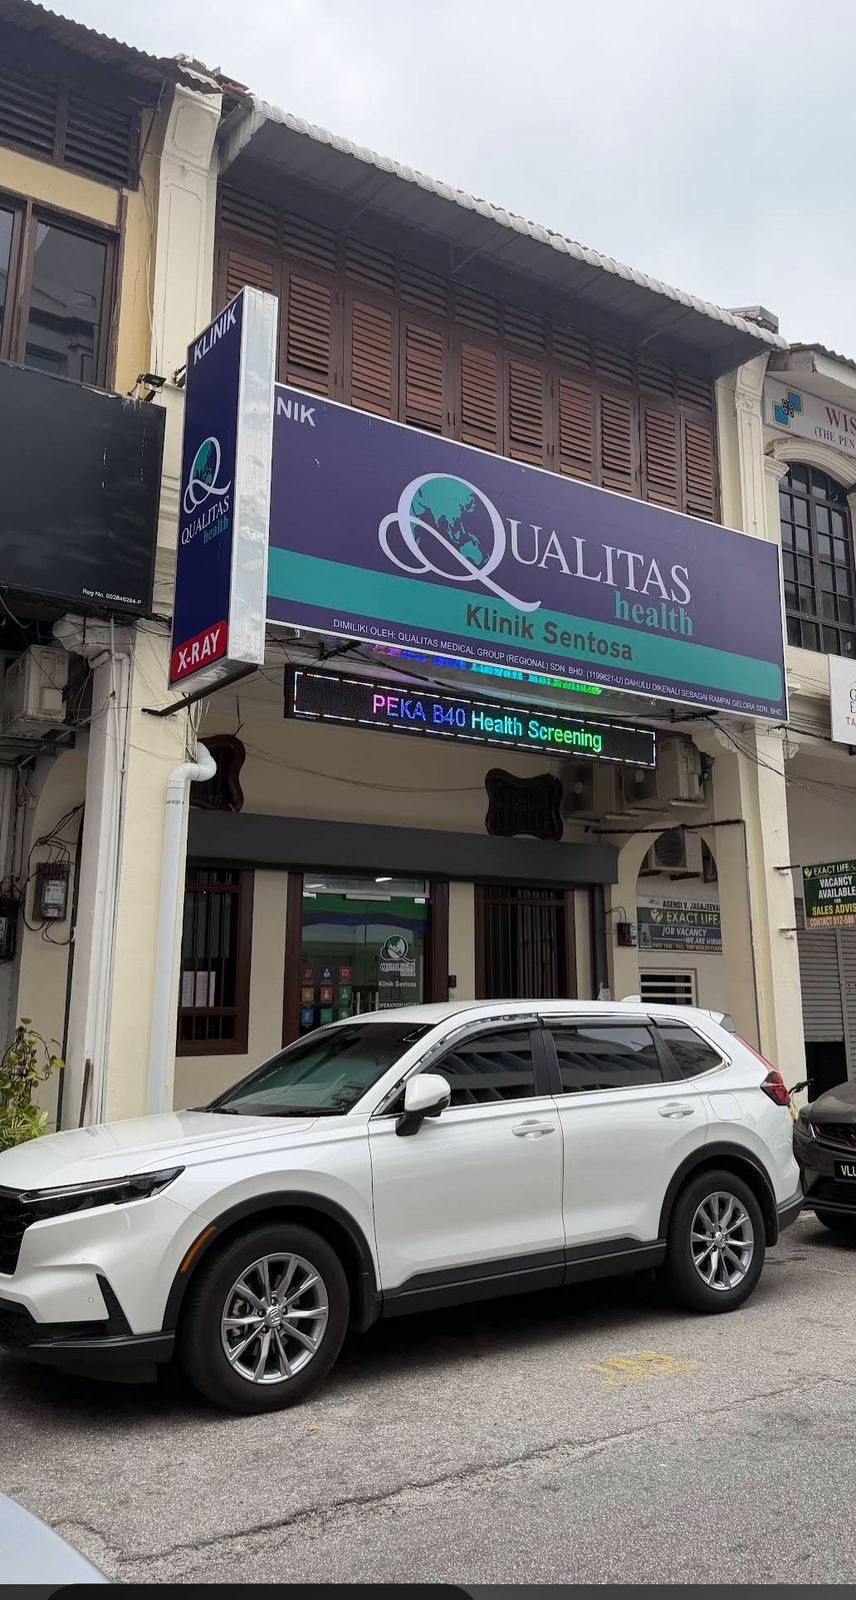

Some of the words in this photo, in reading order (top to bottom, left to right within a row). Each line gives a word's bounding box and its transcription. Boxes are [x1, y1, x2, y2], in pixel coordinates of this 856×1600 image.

[193, 301, 237, 366] KLINIK
[276, 396, 316, 427] NIK
[181, 495, 230, 545] QUALITAS
[203, 514, 229, 544] health
[378, 472, 692, 613] QUALITAS
[82, 588, 94, 597] Reg
[614, 590, 694, 637] health
[466, 603, 535, 640] Klinik
[542, 621, 633, 662] Sentosa
[177, 628, 221, 673] X-RAY
[333, 619, 368, 633] DIMILIKI
[370, 626, 396, 639] OLEH:
[398, 632, 439, 648] QUALITAS
[440, 640, 475, 655] MEDICAL
[477, 647, 505, 660] GROUP
[506, 653, 549, 670] (REGIONAL)
[550, 662, 566, 673] SDN.
[568, 666, 585, 677] BHD.
[624, 678, 651, 690] DAHULU
[652, 683, 681, 696] DIKENALI
[681, 688, 708, 701] SEBAGAI
[708, 695, 731, 706] RAMPAI
[732, 699, 756, 711] GELORA
[372, 694, 427, 722] PEKA
[432, 704, 467, 727] B40
[471, 710, 524, 737] Health
[527, 720, 603, 752] Screening
[813, 865, 835, 876] EXACT
[836, 863, 850, 873] LIFE
[819, 875, 853, 888] VACANCY
[663, 900, 682, 909] AGENSI
[818, 886, 856, 900] AVAILABLE
[666, 911, 699, 924] EXACT
[701, 913, 718, 925] LIFE
[812, 904, 834, 916] SALES
[662, 927, 675, 937] JOB
[676, 928, 707, 937] VACANCY
